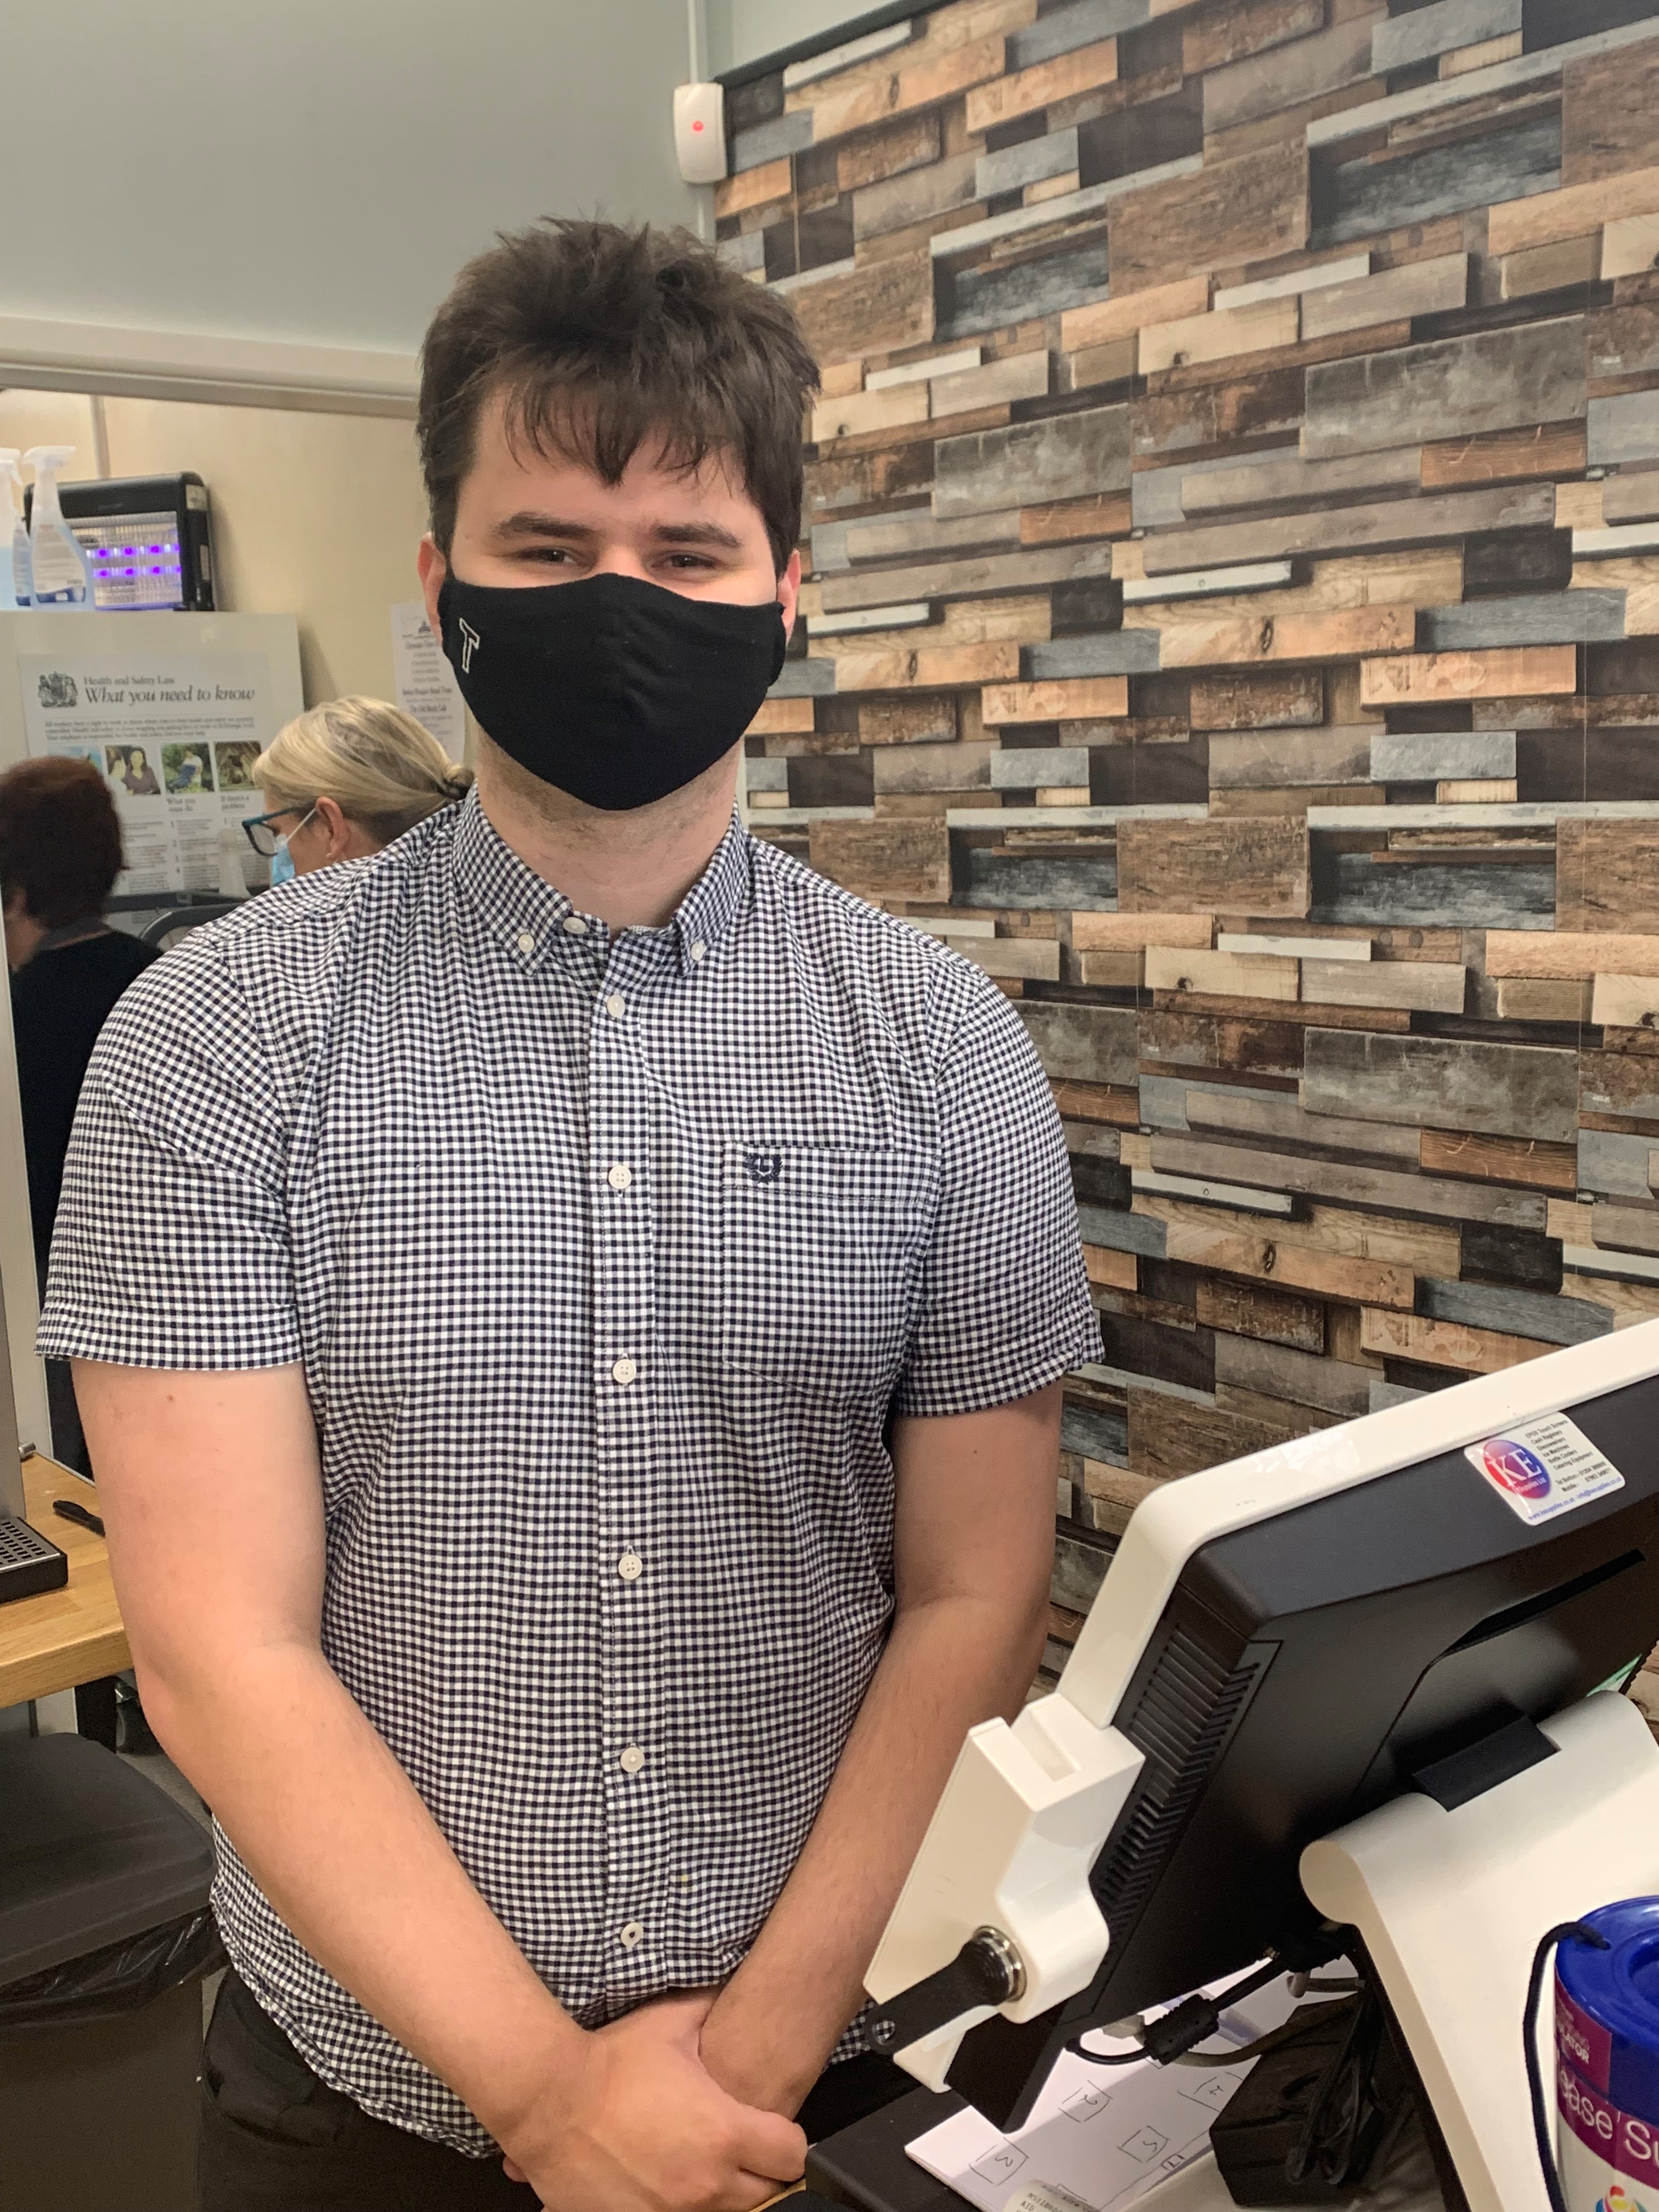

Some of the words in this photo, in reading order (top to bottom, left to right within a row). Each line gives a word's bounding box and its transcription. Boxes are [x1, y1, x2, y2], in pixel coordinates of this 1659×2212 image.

[83, 676, 112, 685] Health
[114, 676, 129, 685] and
[131, 676, 155, 686] Safety
[158, 675, 174, 684] Law
[85, 686, 124, 702] What
[128, 691, 155, 706] you
[160, 685, 193, 701] need
[198, 689, 211, 701] to
[216, 684, 255, 700] know
[1487, 1448, 1542, 1486] KE
[1560, 2067, 1613, 2140] ease
[995, 2154, 1014, 2168] 3
